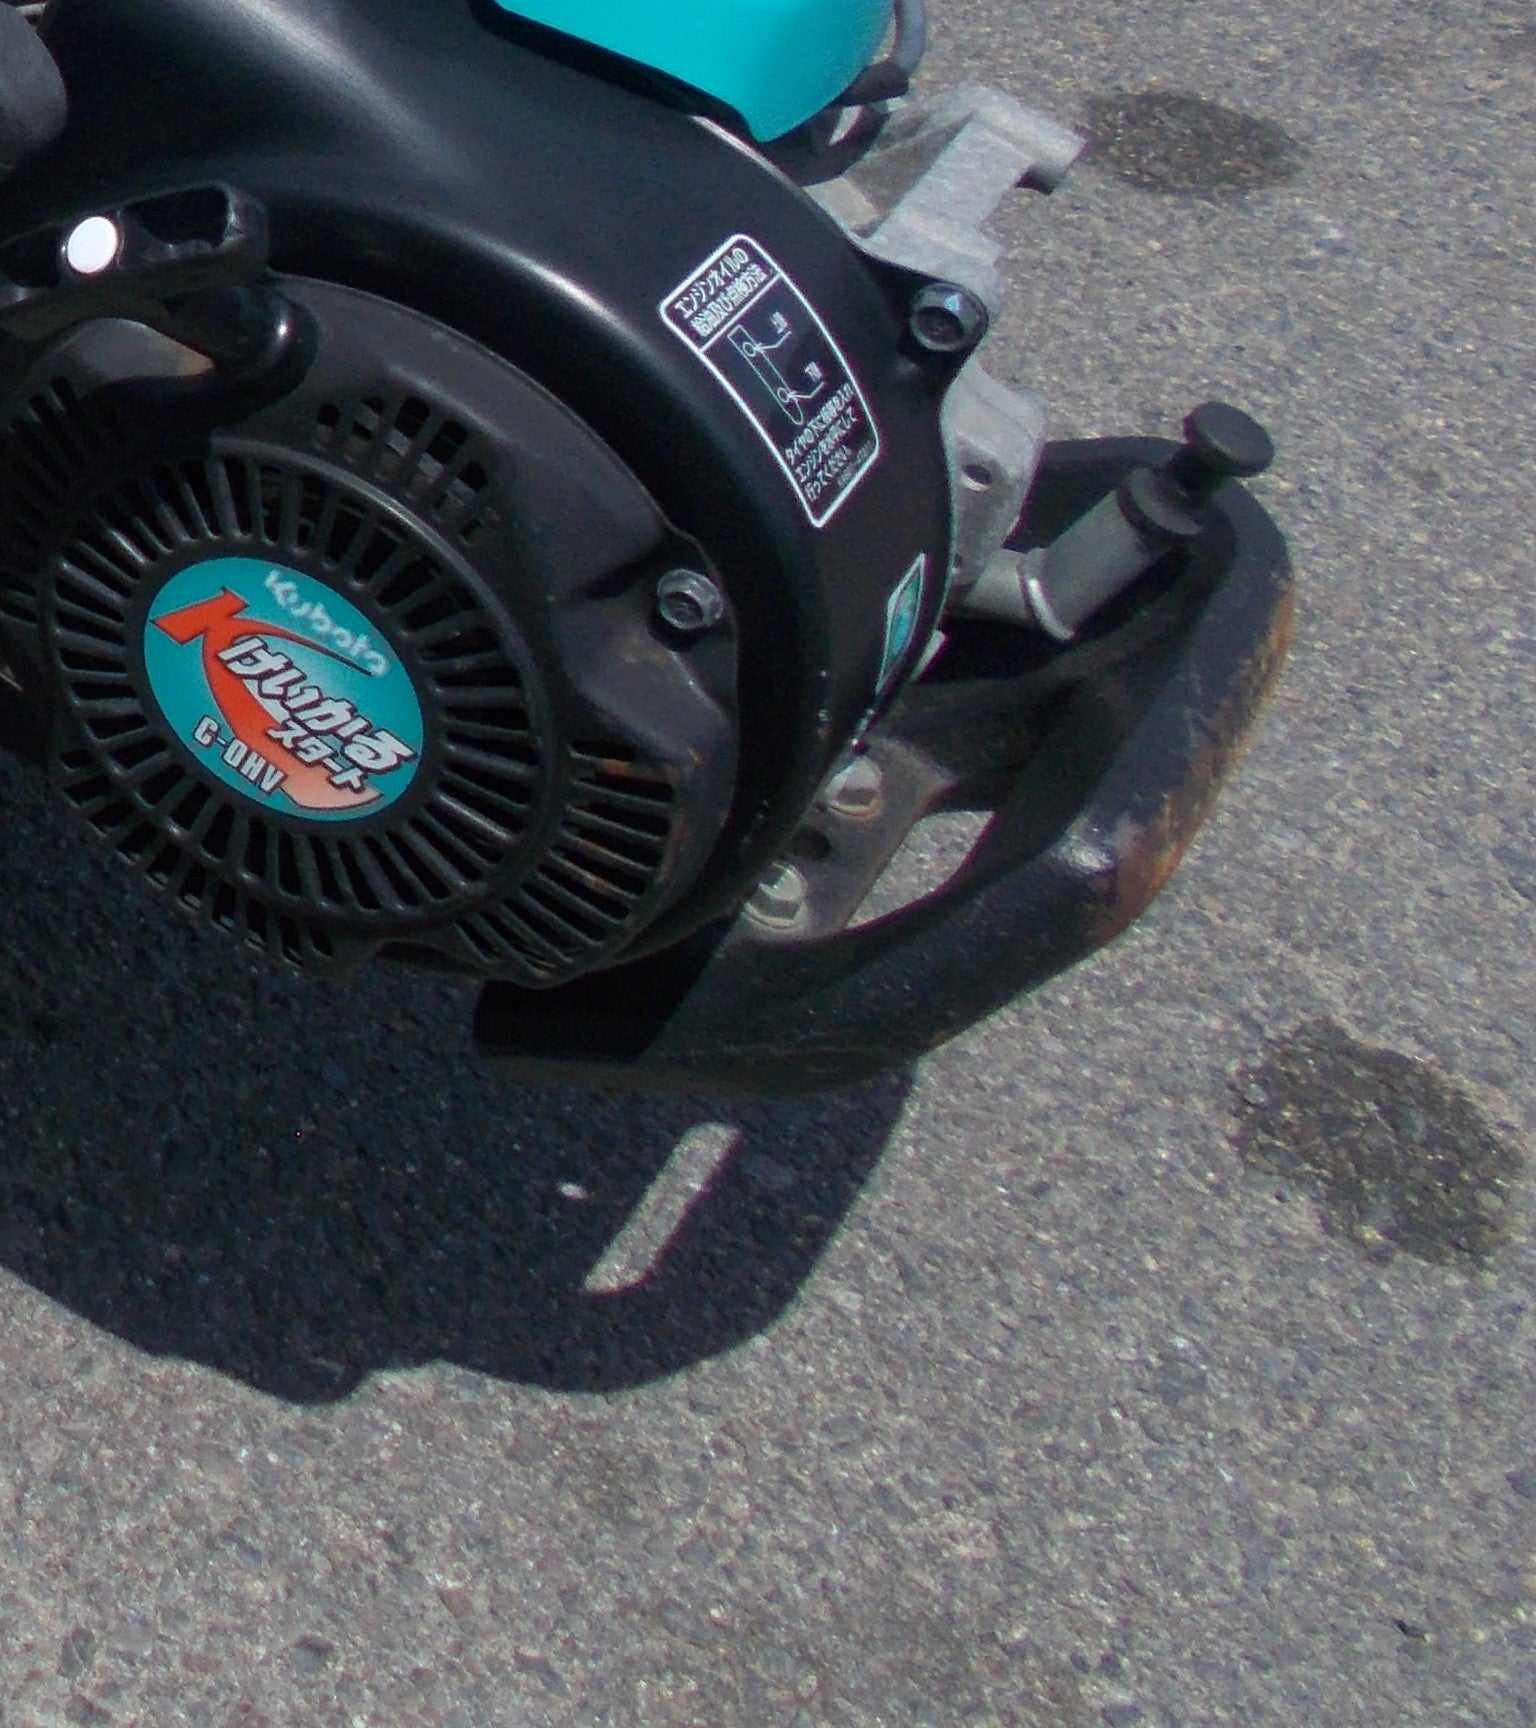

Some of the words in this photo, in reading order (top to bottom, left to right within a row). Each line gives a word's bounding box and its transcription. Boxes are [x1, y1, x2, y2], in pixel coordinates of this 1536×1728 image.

[672, 245, 752, 319] エンジンオイルの
[263, 569, 390, 677] Kubota
[267, 721, 367, 792] スタート
